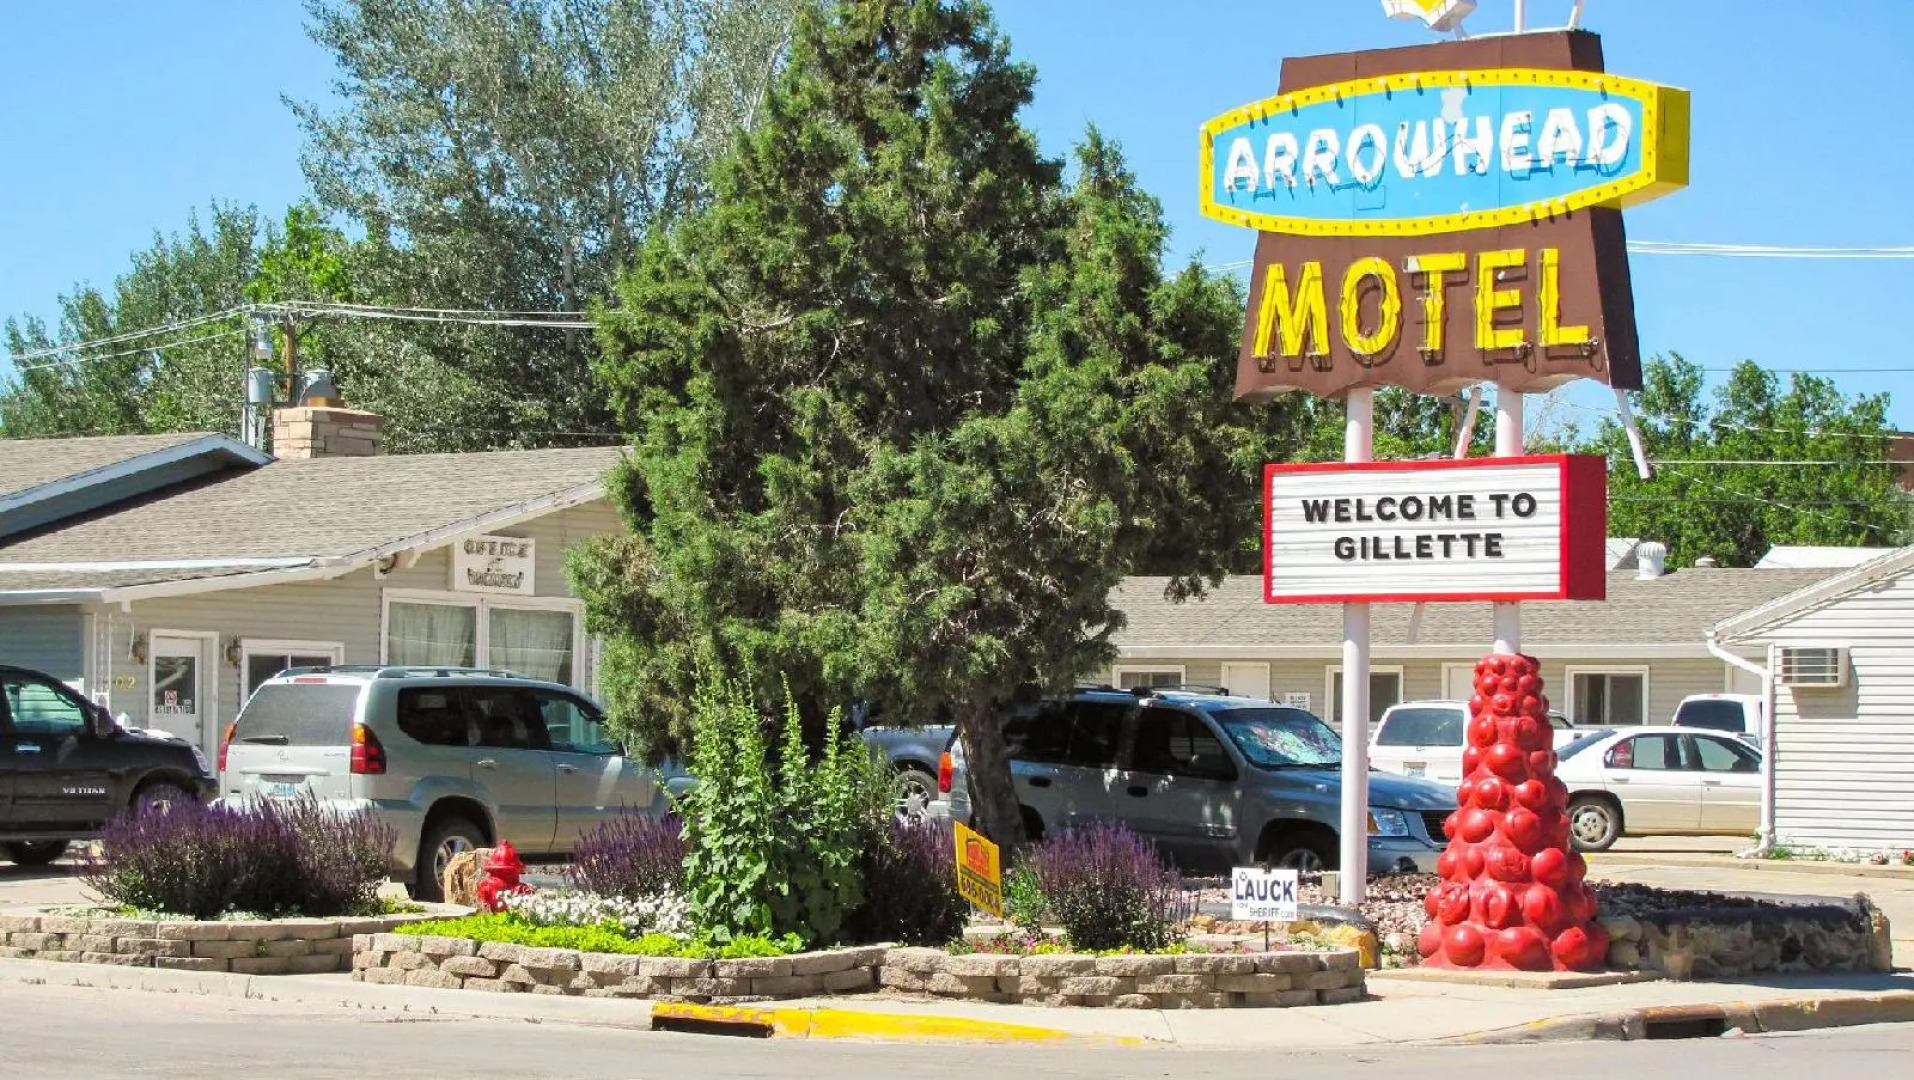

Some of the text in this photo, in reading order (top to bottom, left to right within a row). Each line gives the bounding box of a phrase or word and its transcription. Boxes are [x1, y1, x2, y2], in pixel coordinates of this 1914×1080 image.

[1224, 103, 1632, 192] ARROWHEAD
[1251, 248, 1590, 358] MOTEL
[1302, 492, 1537, 523] WELCOME TO
[1334, 533, 1504, 560] GILLETTE
[1235, 879, 1294, 902] LAUCK
